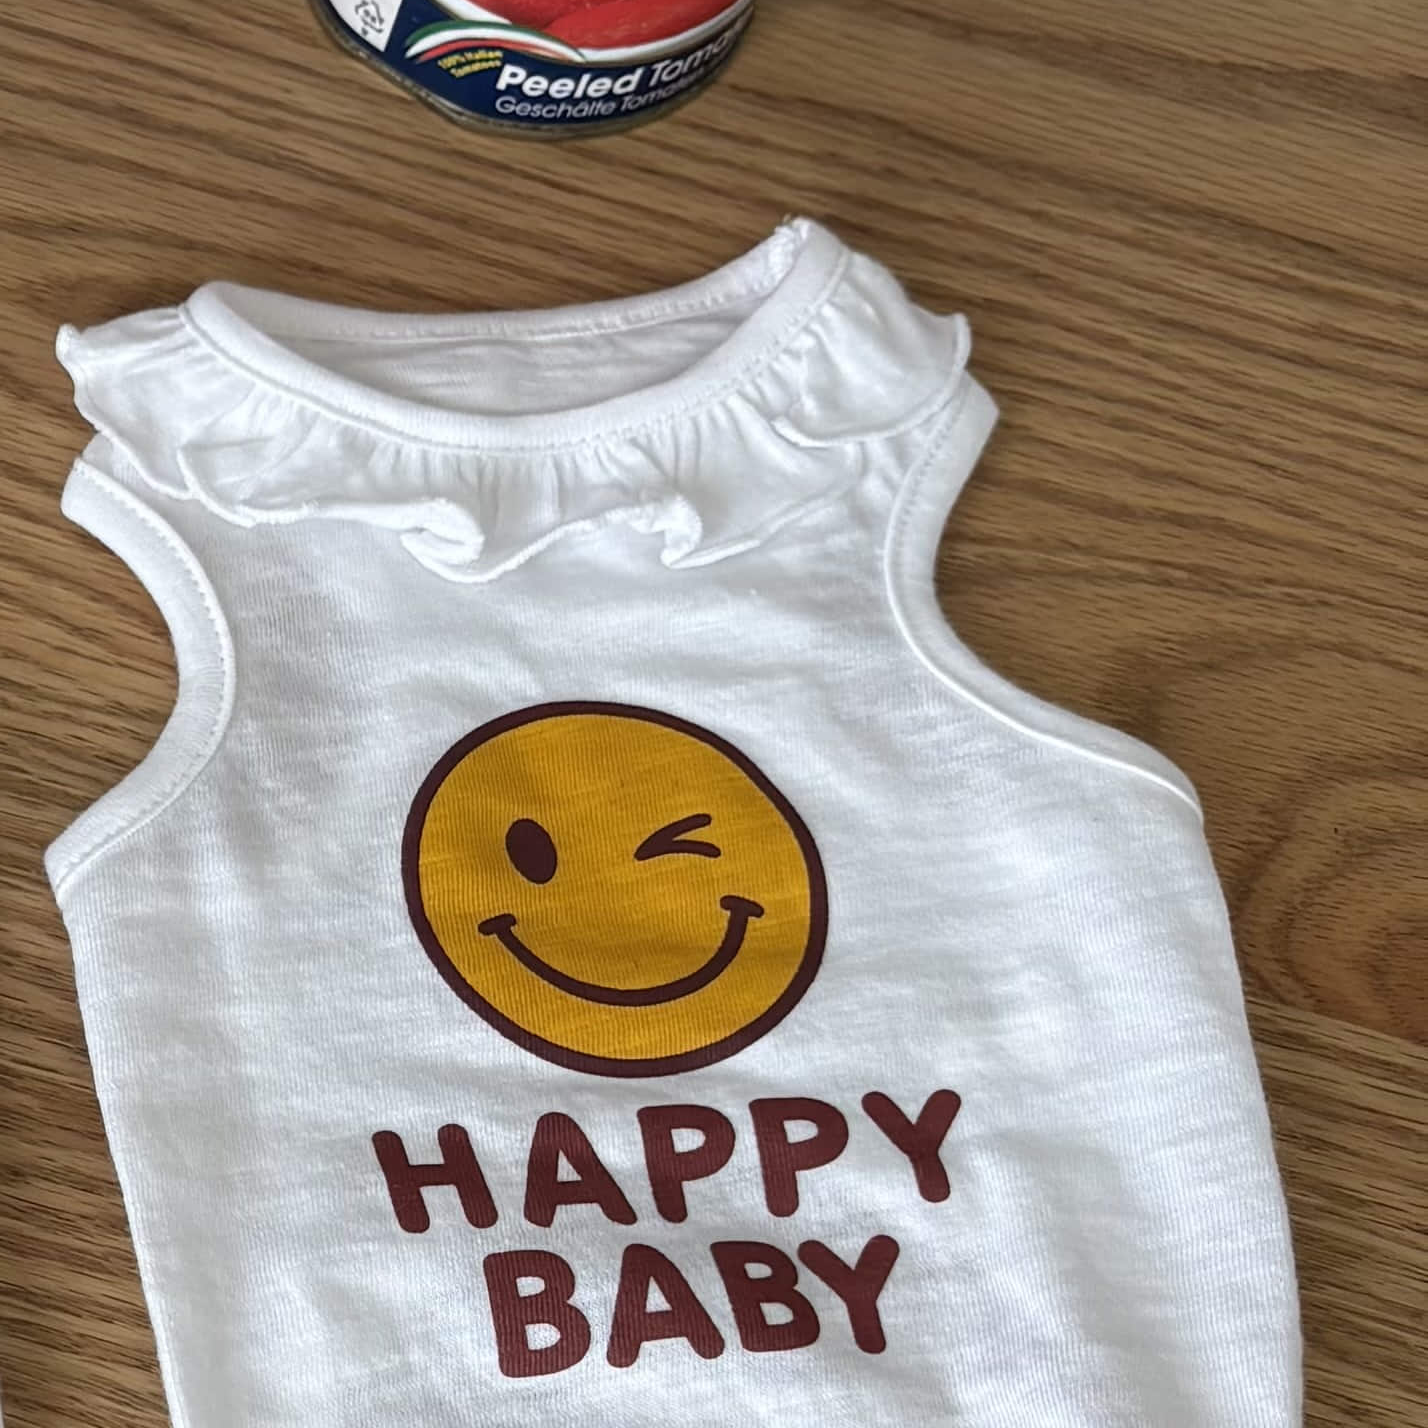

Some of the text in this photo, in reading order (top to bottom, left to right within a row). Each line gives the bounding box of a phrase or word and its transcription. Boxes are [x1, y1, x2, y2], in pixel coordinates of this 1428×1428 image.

[495, 63, 645, 100] Peeled
[372, 1088, 962, 1234] HAPPY
[483, 1234, 901, 1379] BABY
